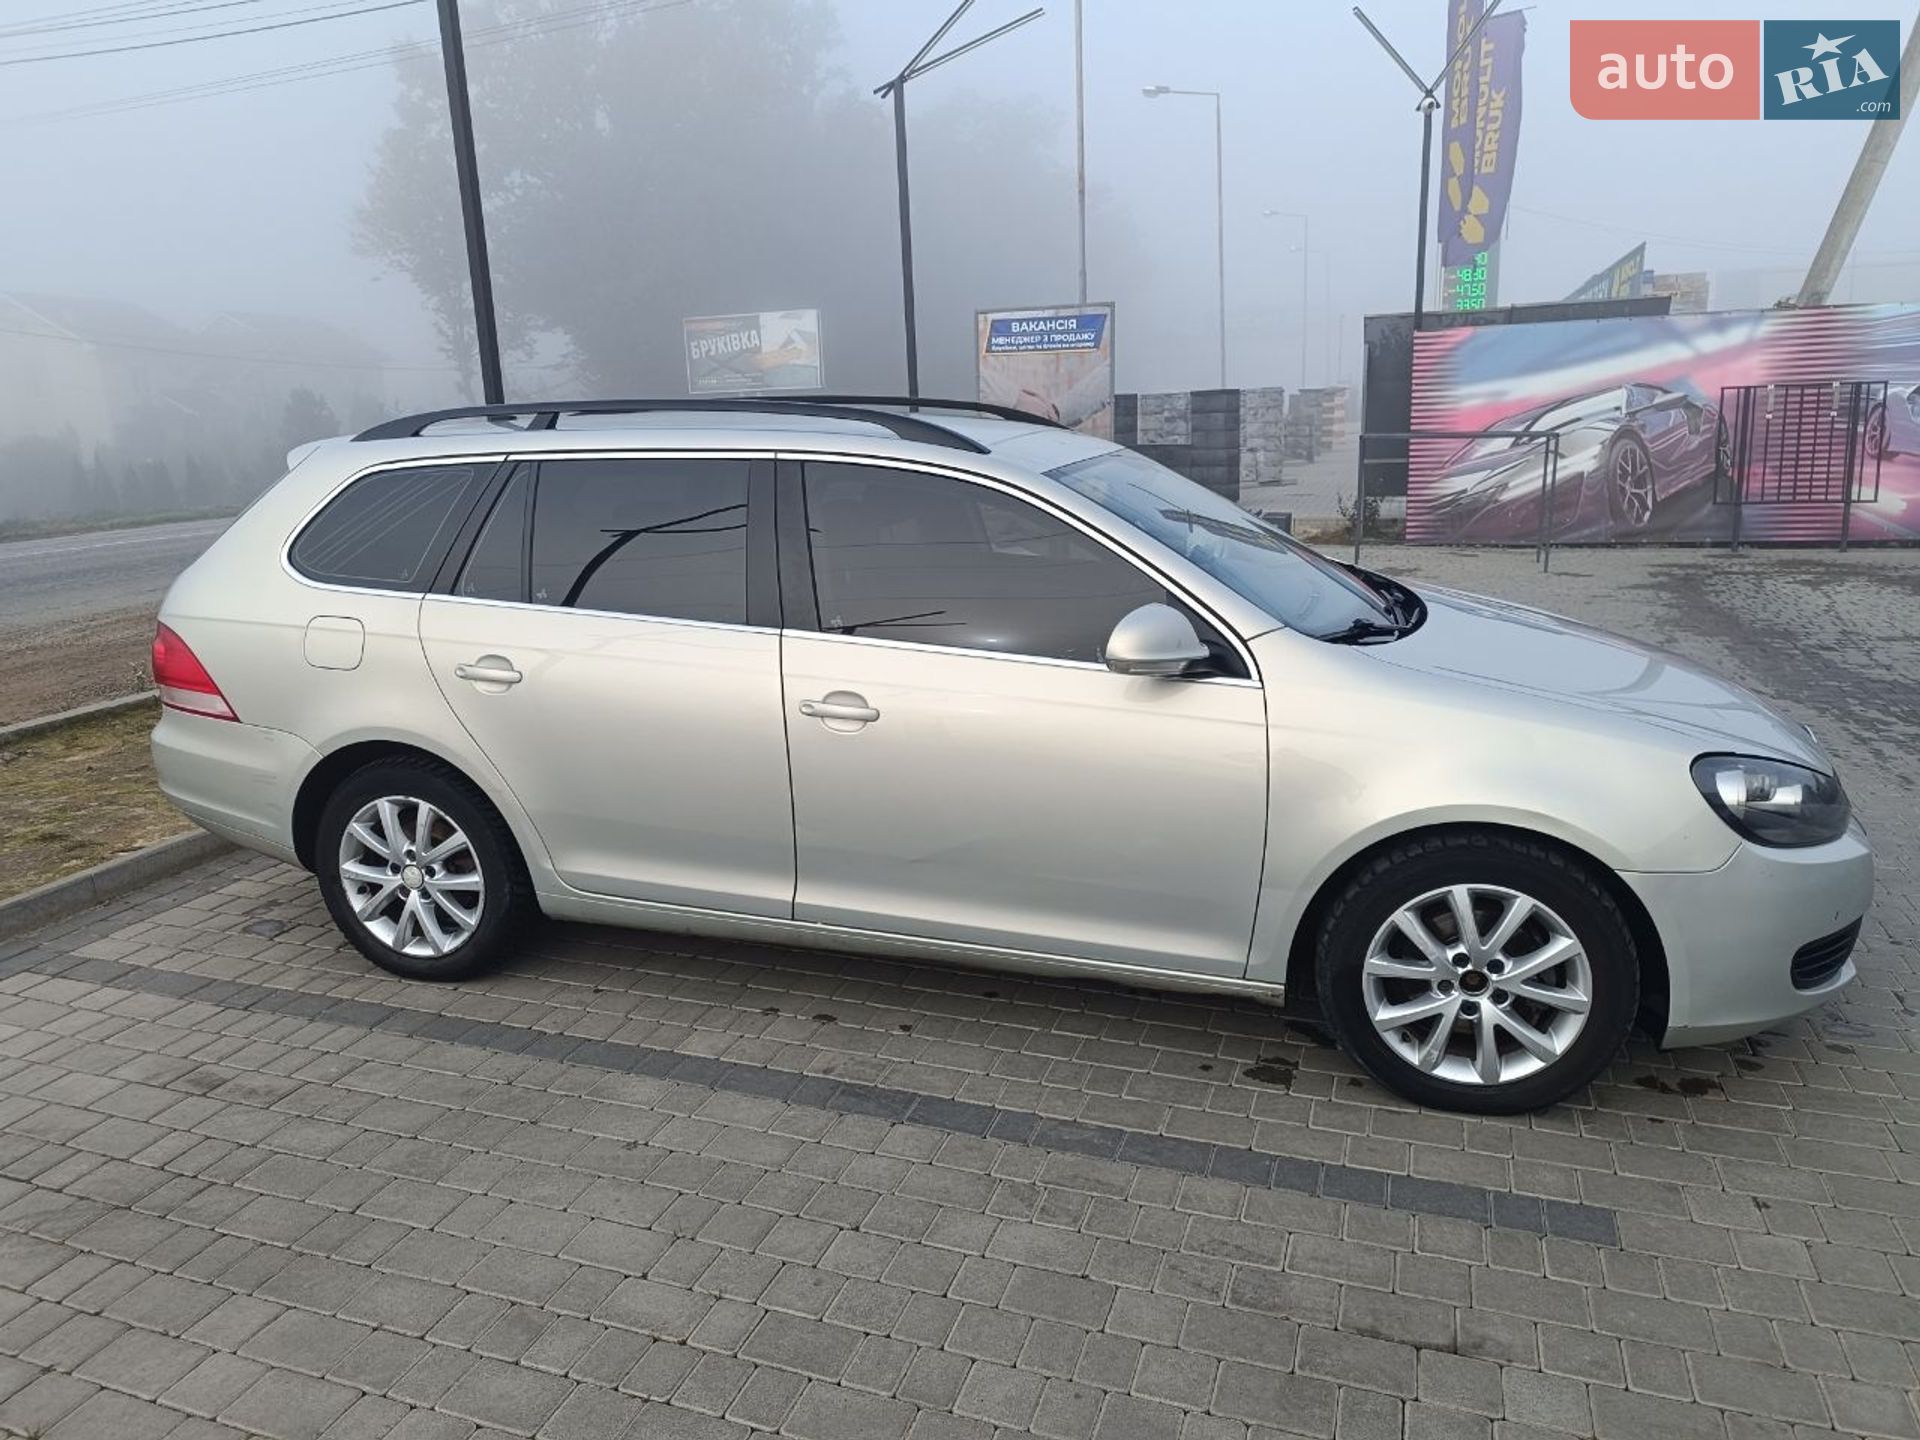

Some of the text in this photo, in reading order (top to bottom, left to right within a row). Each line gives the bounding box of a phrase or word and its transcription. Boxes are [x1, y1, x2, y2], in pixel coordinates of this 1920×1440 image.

[1481, 87, 1506, 173] BRUK
[1011, 319, 1077, 333] ВАКАНСІЯ
[690, 329, 761, 359] БРУКІВКА
[991, 334, 1041, 345] МЕНЕДЖЕР
[1050, 331, 1095, 343] ПРОДАЖУ
